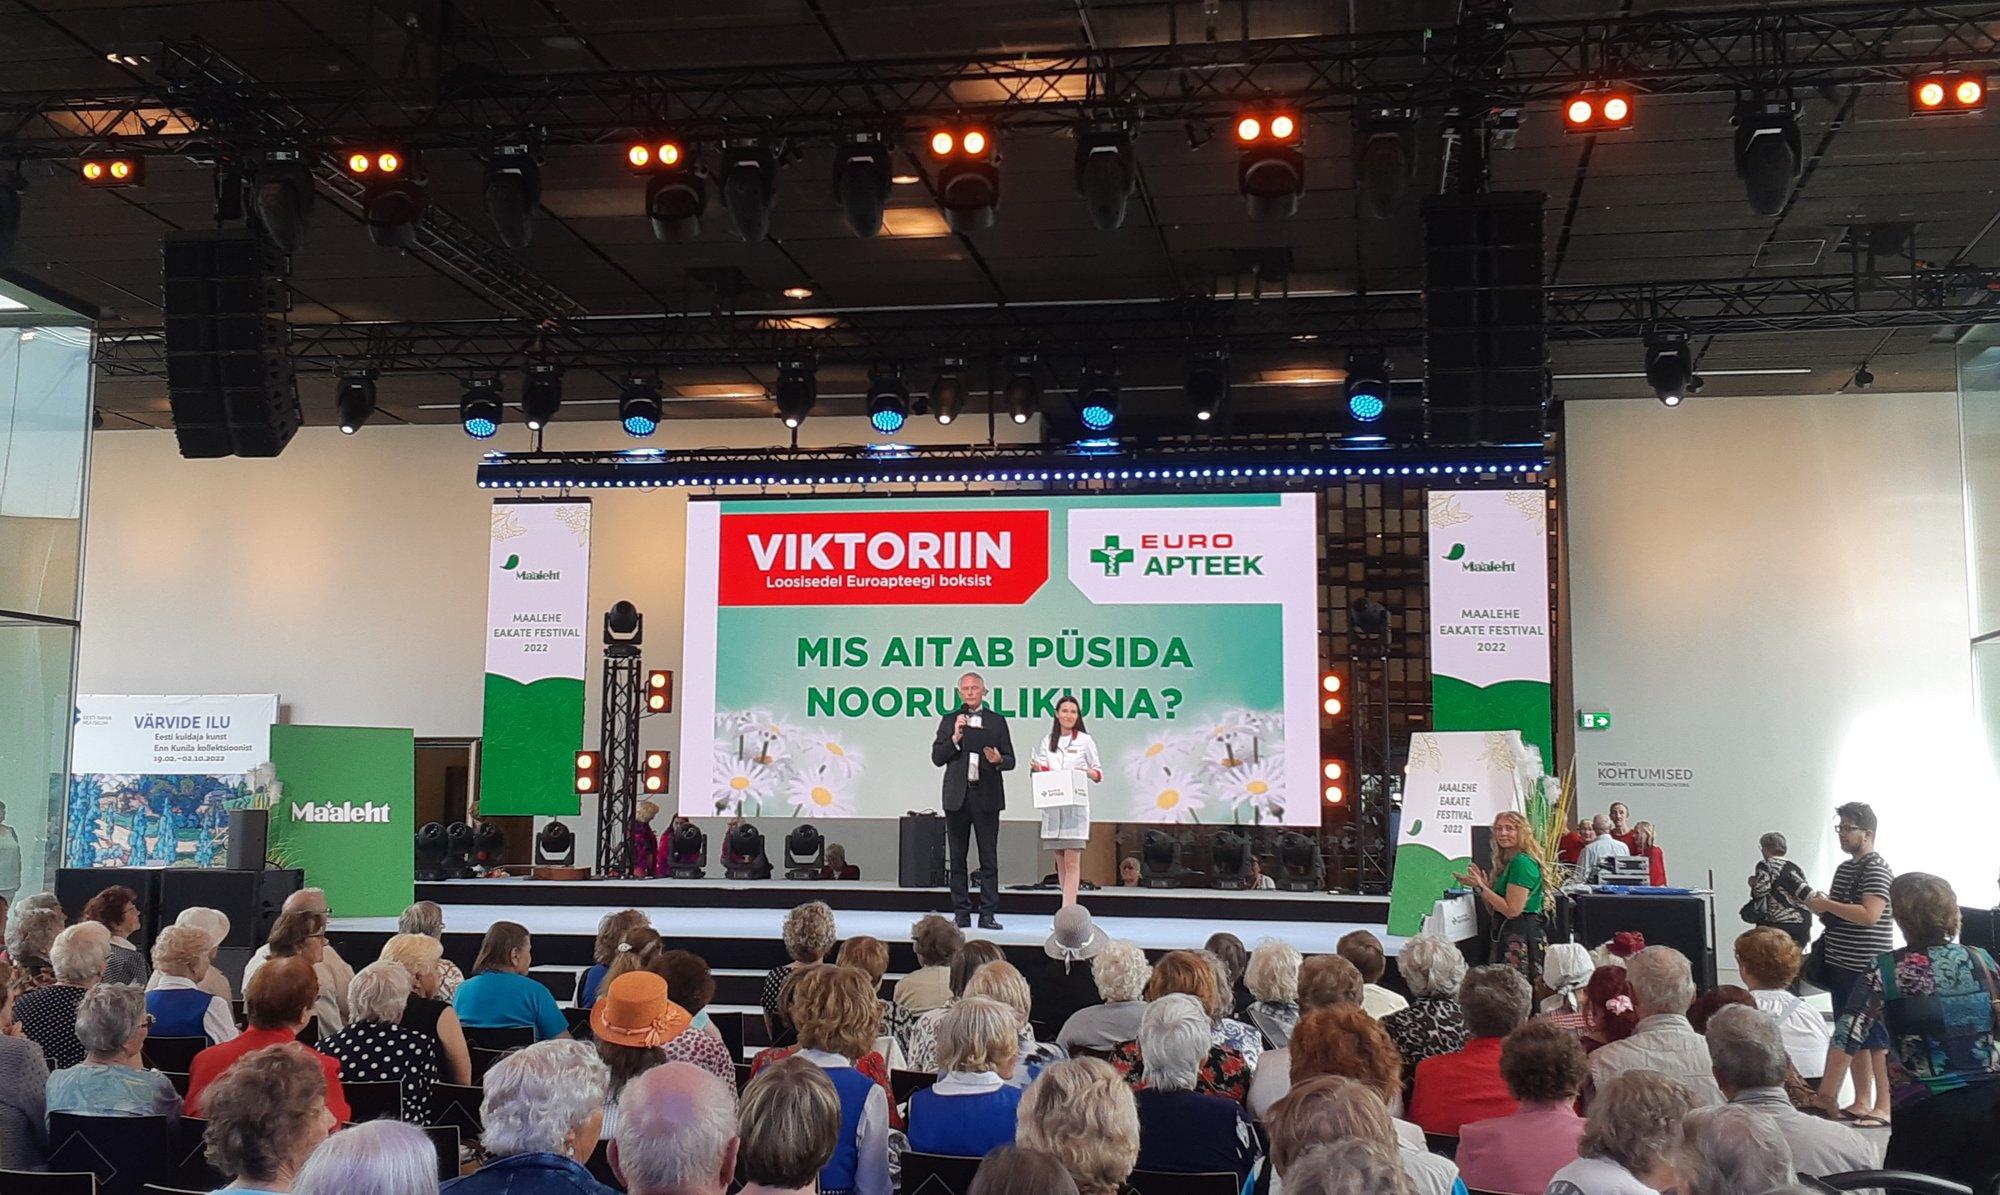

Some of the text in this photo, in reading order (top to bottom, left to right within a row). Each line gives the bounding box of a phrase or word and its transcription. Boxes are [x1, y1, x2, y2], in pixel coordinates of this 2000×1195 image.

[1141, 534, 1233, 549] EURO
[747, 531, 1011, 570] VIKTORIIN
[1143, 555, 1264, 576] APTEEK
[766, 575, 991, 590] Loosisedel Euroapteegi boksist
[513, 614, 561, 622] MAALEHE
[1461, 610, 1520, 618] MAALEHE
[494, 629, 580, 637] EAKATE FESTIVAL
[1440, 626, 1544, 635] EAKATE FESTIVAL
[524, 644, 548, 652] 2022
[798, 629, 1194, 667] MIS AITAB PÜSIDA
[1477, 643, 1506, 651] 2022
[807, 687, 1183, 719] NOORULIKUNA?
[134, 713, 231, 728] VÄRVIDE ILU
[171, 744, 195, 752] Kunila
[197, 744, 252, 752] kollektsioonist
[1598, 768, 1693, 780] KOHTUMISED
[1438, 783, 1477, 792] MAALEHE
[1440, 797, 1470, 806] EAKATE
[292, 801, 391, 822] Maaleht
[1436, 811, 1473, 820] FESTIVAL
[1443, 825, 1462, 833] 2022
